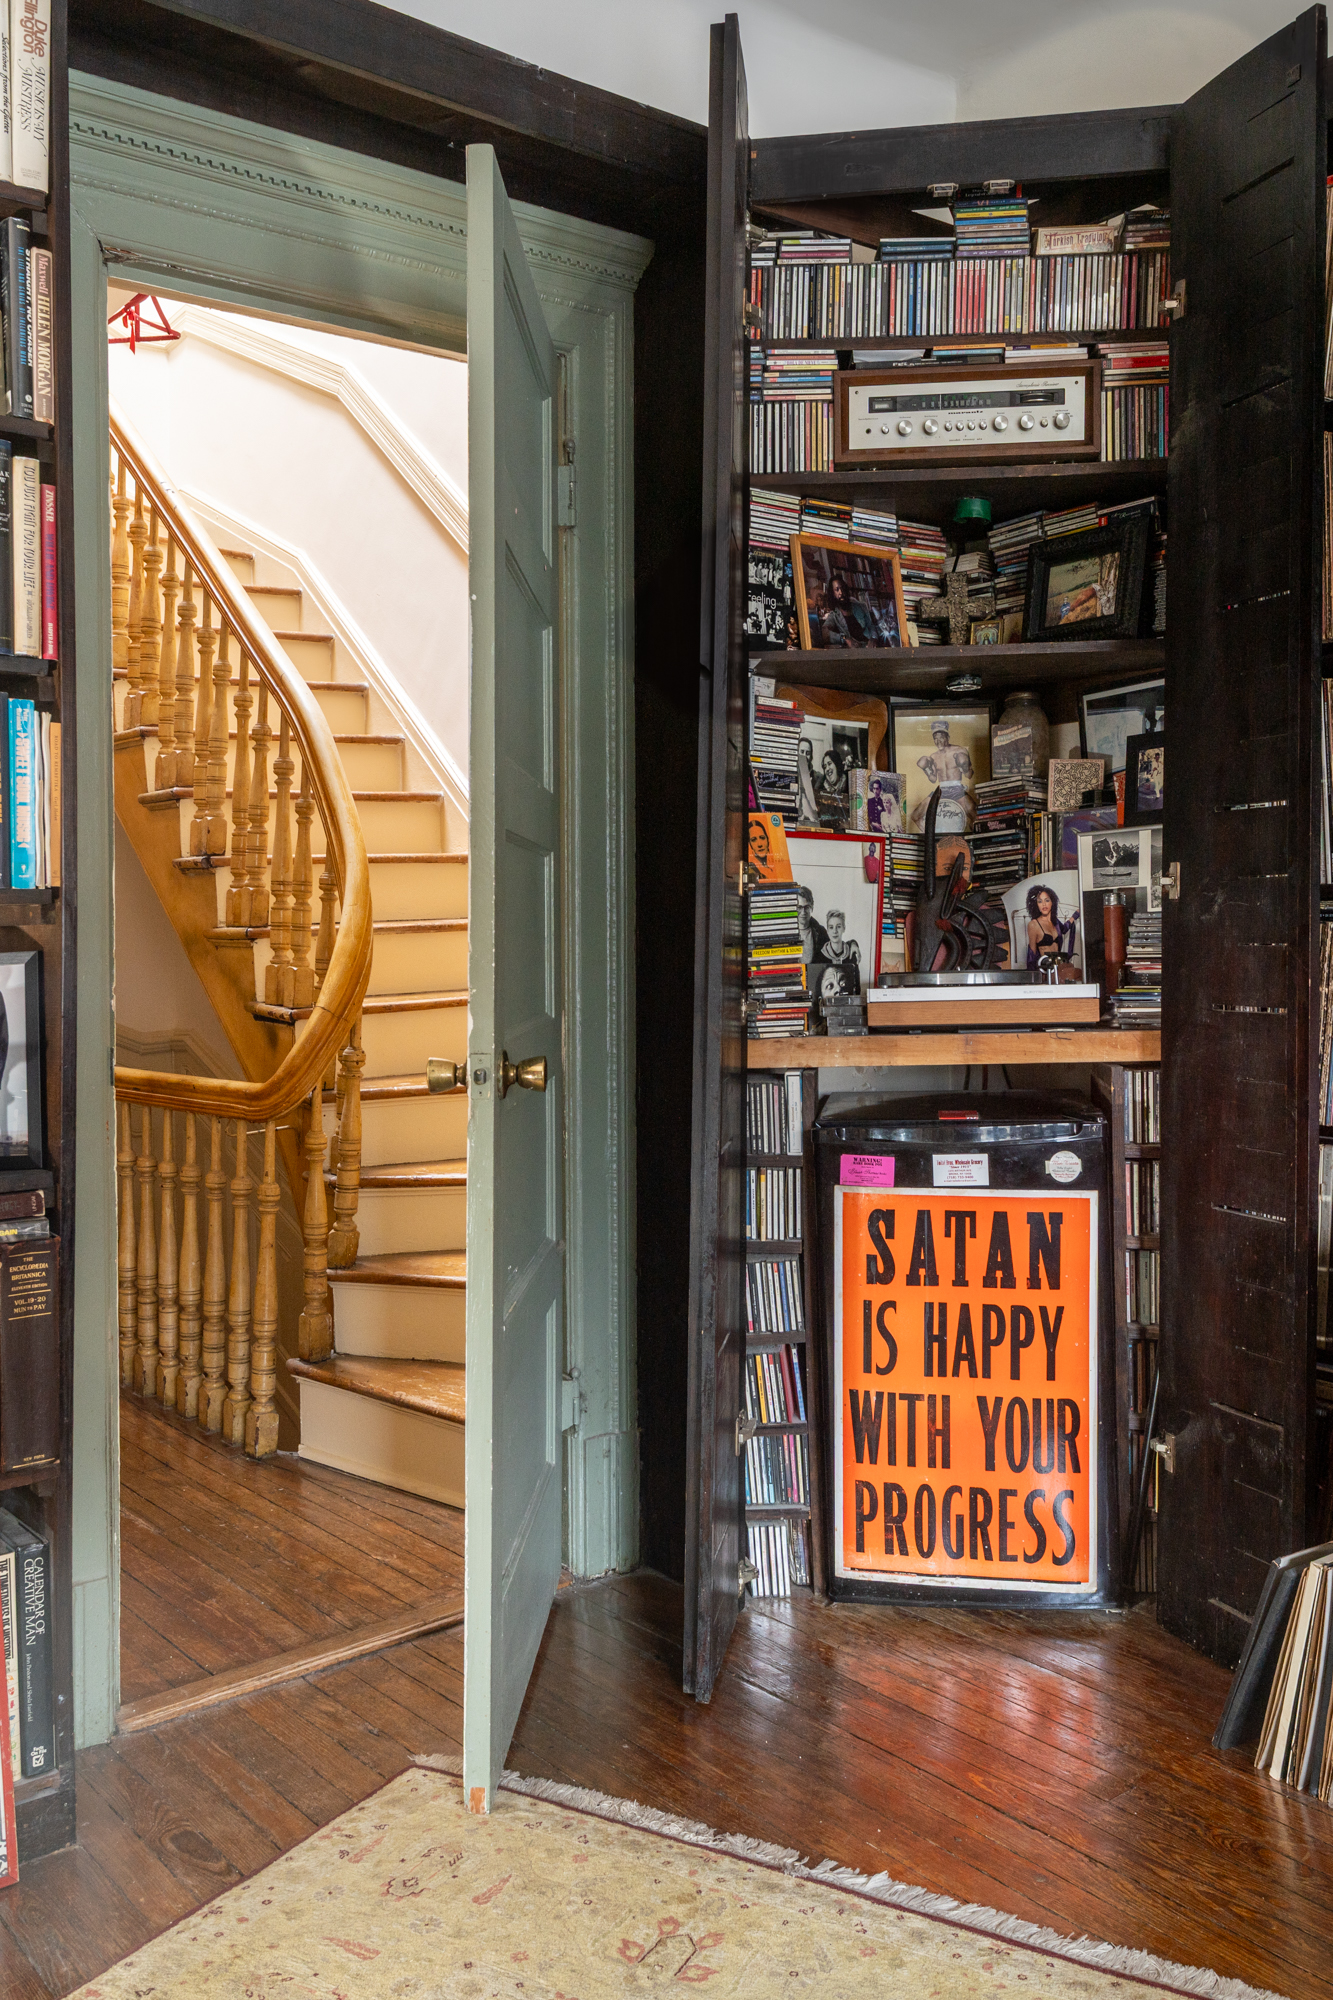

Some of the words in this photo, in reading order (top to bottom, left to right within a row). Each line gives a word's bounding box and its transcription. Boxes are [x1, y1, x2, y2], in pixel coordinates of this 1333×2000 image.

[2, 32, 10, 71] Selections
[34, 19, 48, 58] Duke
[0, 72, 10, 93] from
[16, 59, 32, 132] MISTRESS
[31, 58, 46, 108] MUSIC
[2, 94, 11, 108] the
[34, 109, 45, 122] IS
[33, 122, 47, 157] MY
[1044, 232, 1074, 250] Turkish
[38, 255, 49, 294] Maxwell
[37, 294, 51, 339] HELEN
[37, 340, 51, 396] MORGAN
[24, 466, 35, 483] YOU
[24, 484, 35, 502] JUST
[24, 504, 35, 527] FIGHT
[24, 529, 35, 546] FOR
[24, 547, 36, 570] YOUR
[24, 571, 36, 588] LIFE
[16, 738, 29, 775] SWEET
[54, 751, 58, 759] TO
[16, 775, 30, 804] SOUL
[17, 806, 30, 842] MUSIC
[866, 1208, 1063, 1290] SATAN
[11, 1272, 46, 1281] BRITANNICA
[863, 1300, 898, 1376] IS
[923, 1302, 1064, 1381] HAPPY
[848, 1390, 950, 1469] WITH
[977, 1396, 1081, 1474] YOUR
[855, 1480, 1075, 1566] PROGRESS
[24, 1558, 35, 1613] CREATIVE
[34, 1557, 45, 1618] CALENDAR
[25, 1616, 36, 1646] MAN
[35, 1620, 45, 1635] OF
